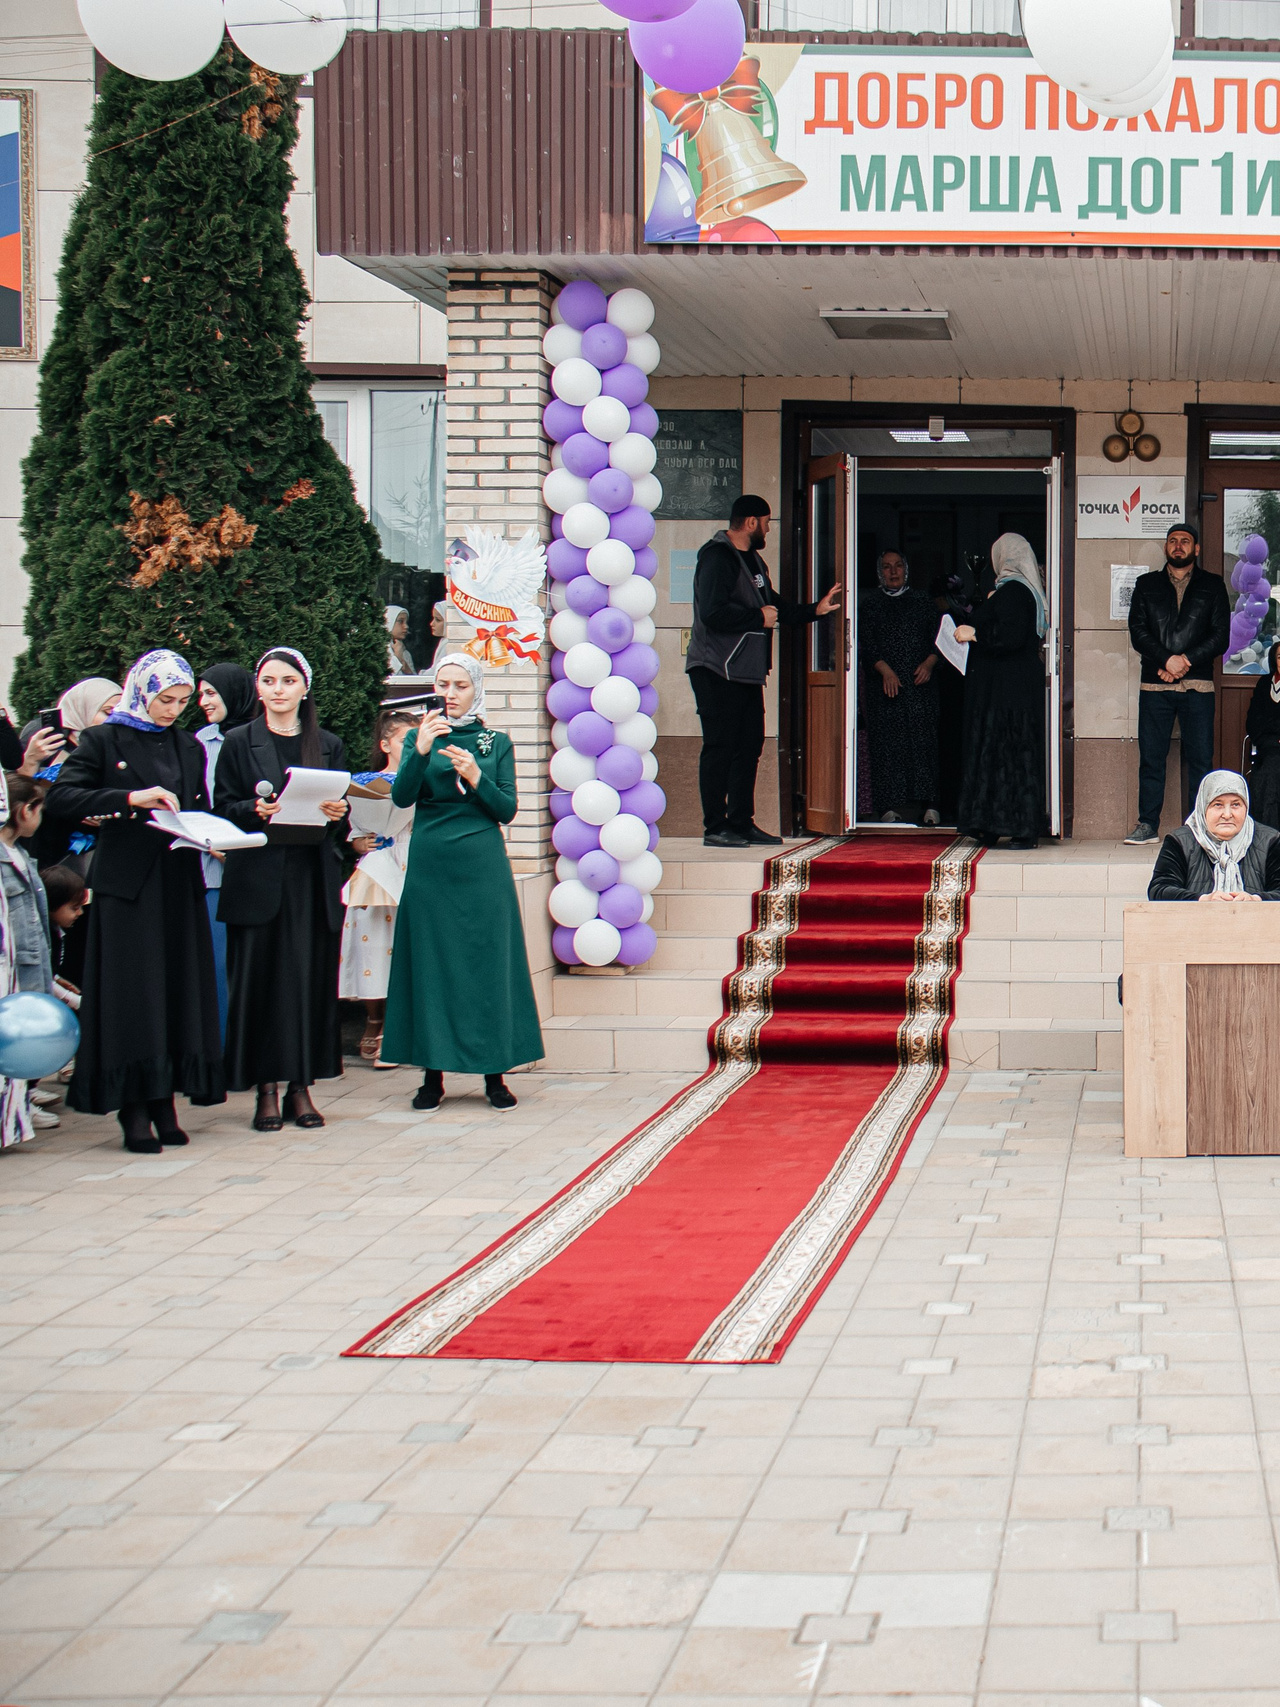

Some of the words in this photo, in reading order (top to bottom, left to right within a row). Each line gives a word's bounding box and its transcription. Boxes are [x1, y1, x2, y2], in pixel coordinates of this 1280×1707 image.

[804, 72, 1004, 135] ДОБРО
[840, 154, 1062, 213] МАРША
[1079, 503, 1120, 515] ТОЧКА
[1141, 503, 1180, 515] РОСТА
[453, 589, 514, 622] ВЫПУСКНИК
